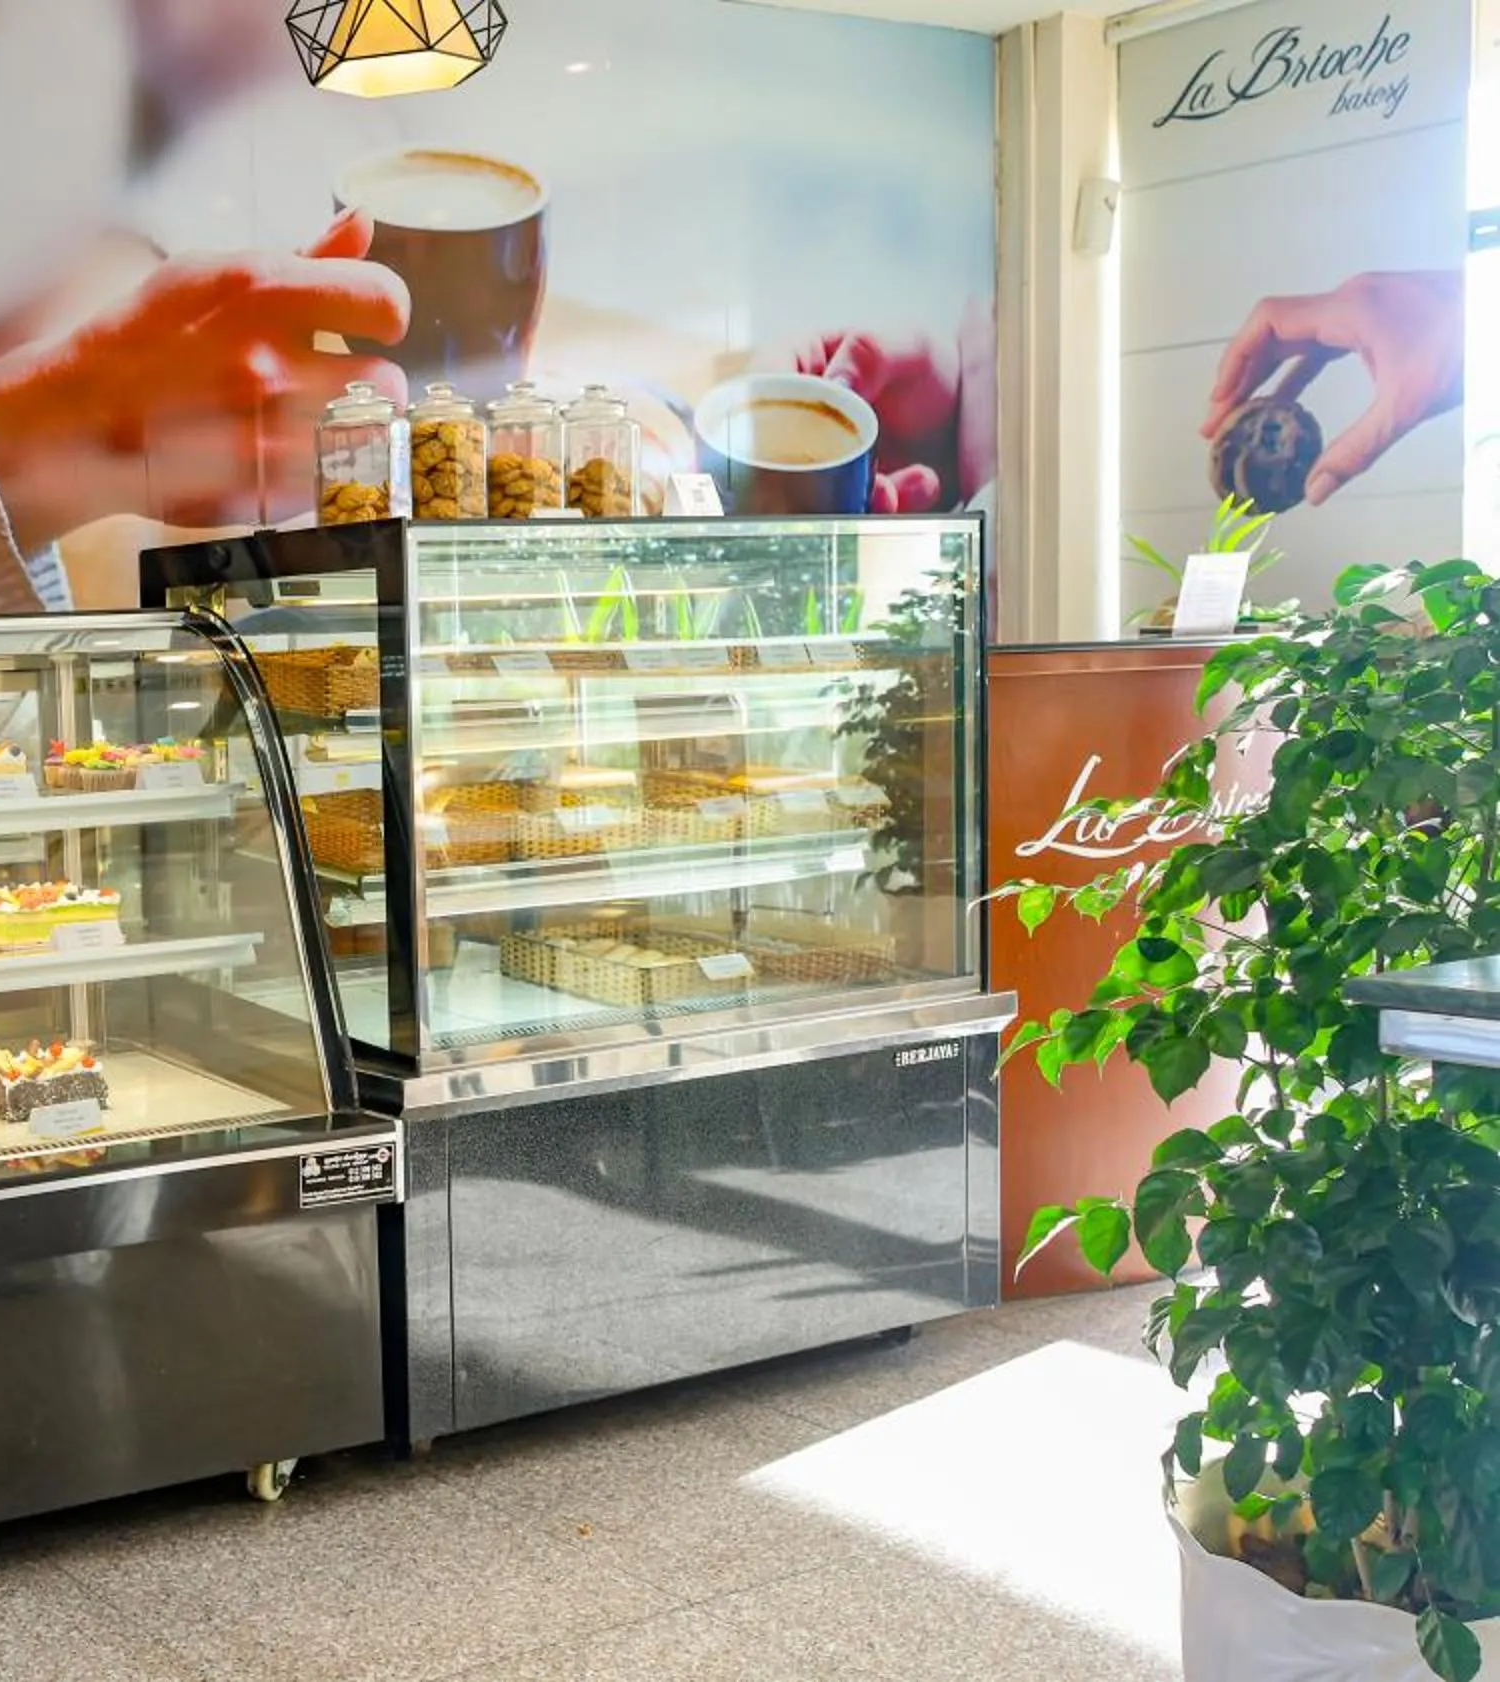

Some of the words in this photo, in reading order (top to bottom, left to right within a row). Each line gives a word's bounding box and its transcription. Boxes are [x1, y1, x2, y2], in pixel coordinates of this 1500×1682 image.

[1152, 49, 1237, 129] La
[1227, 14, 1410, 101] Brioche
[1329, 74, 1410, 119] bakery
[901, 1043, 953, 1067] BERJAYA
